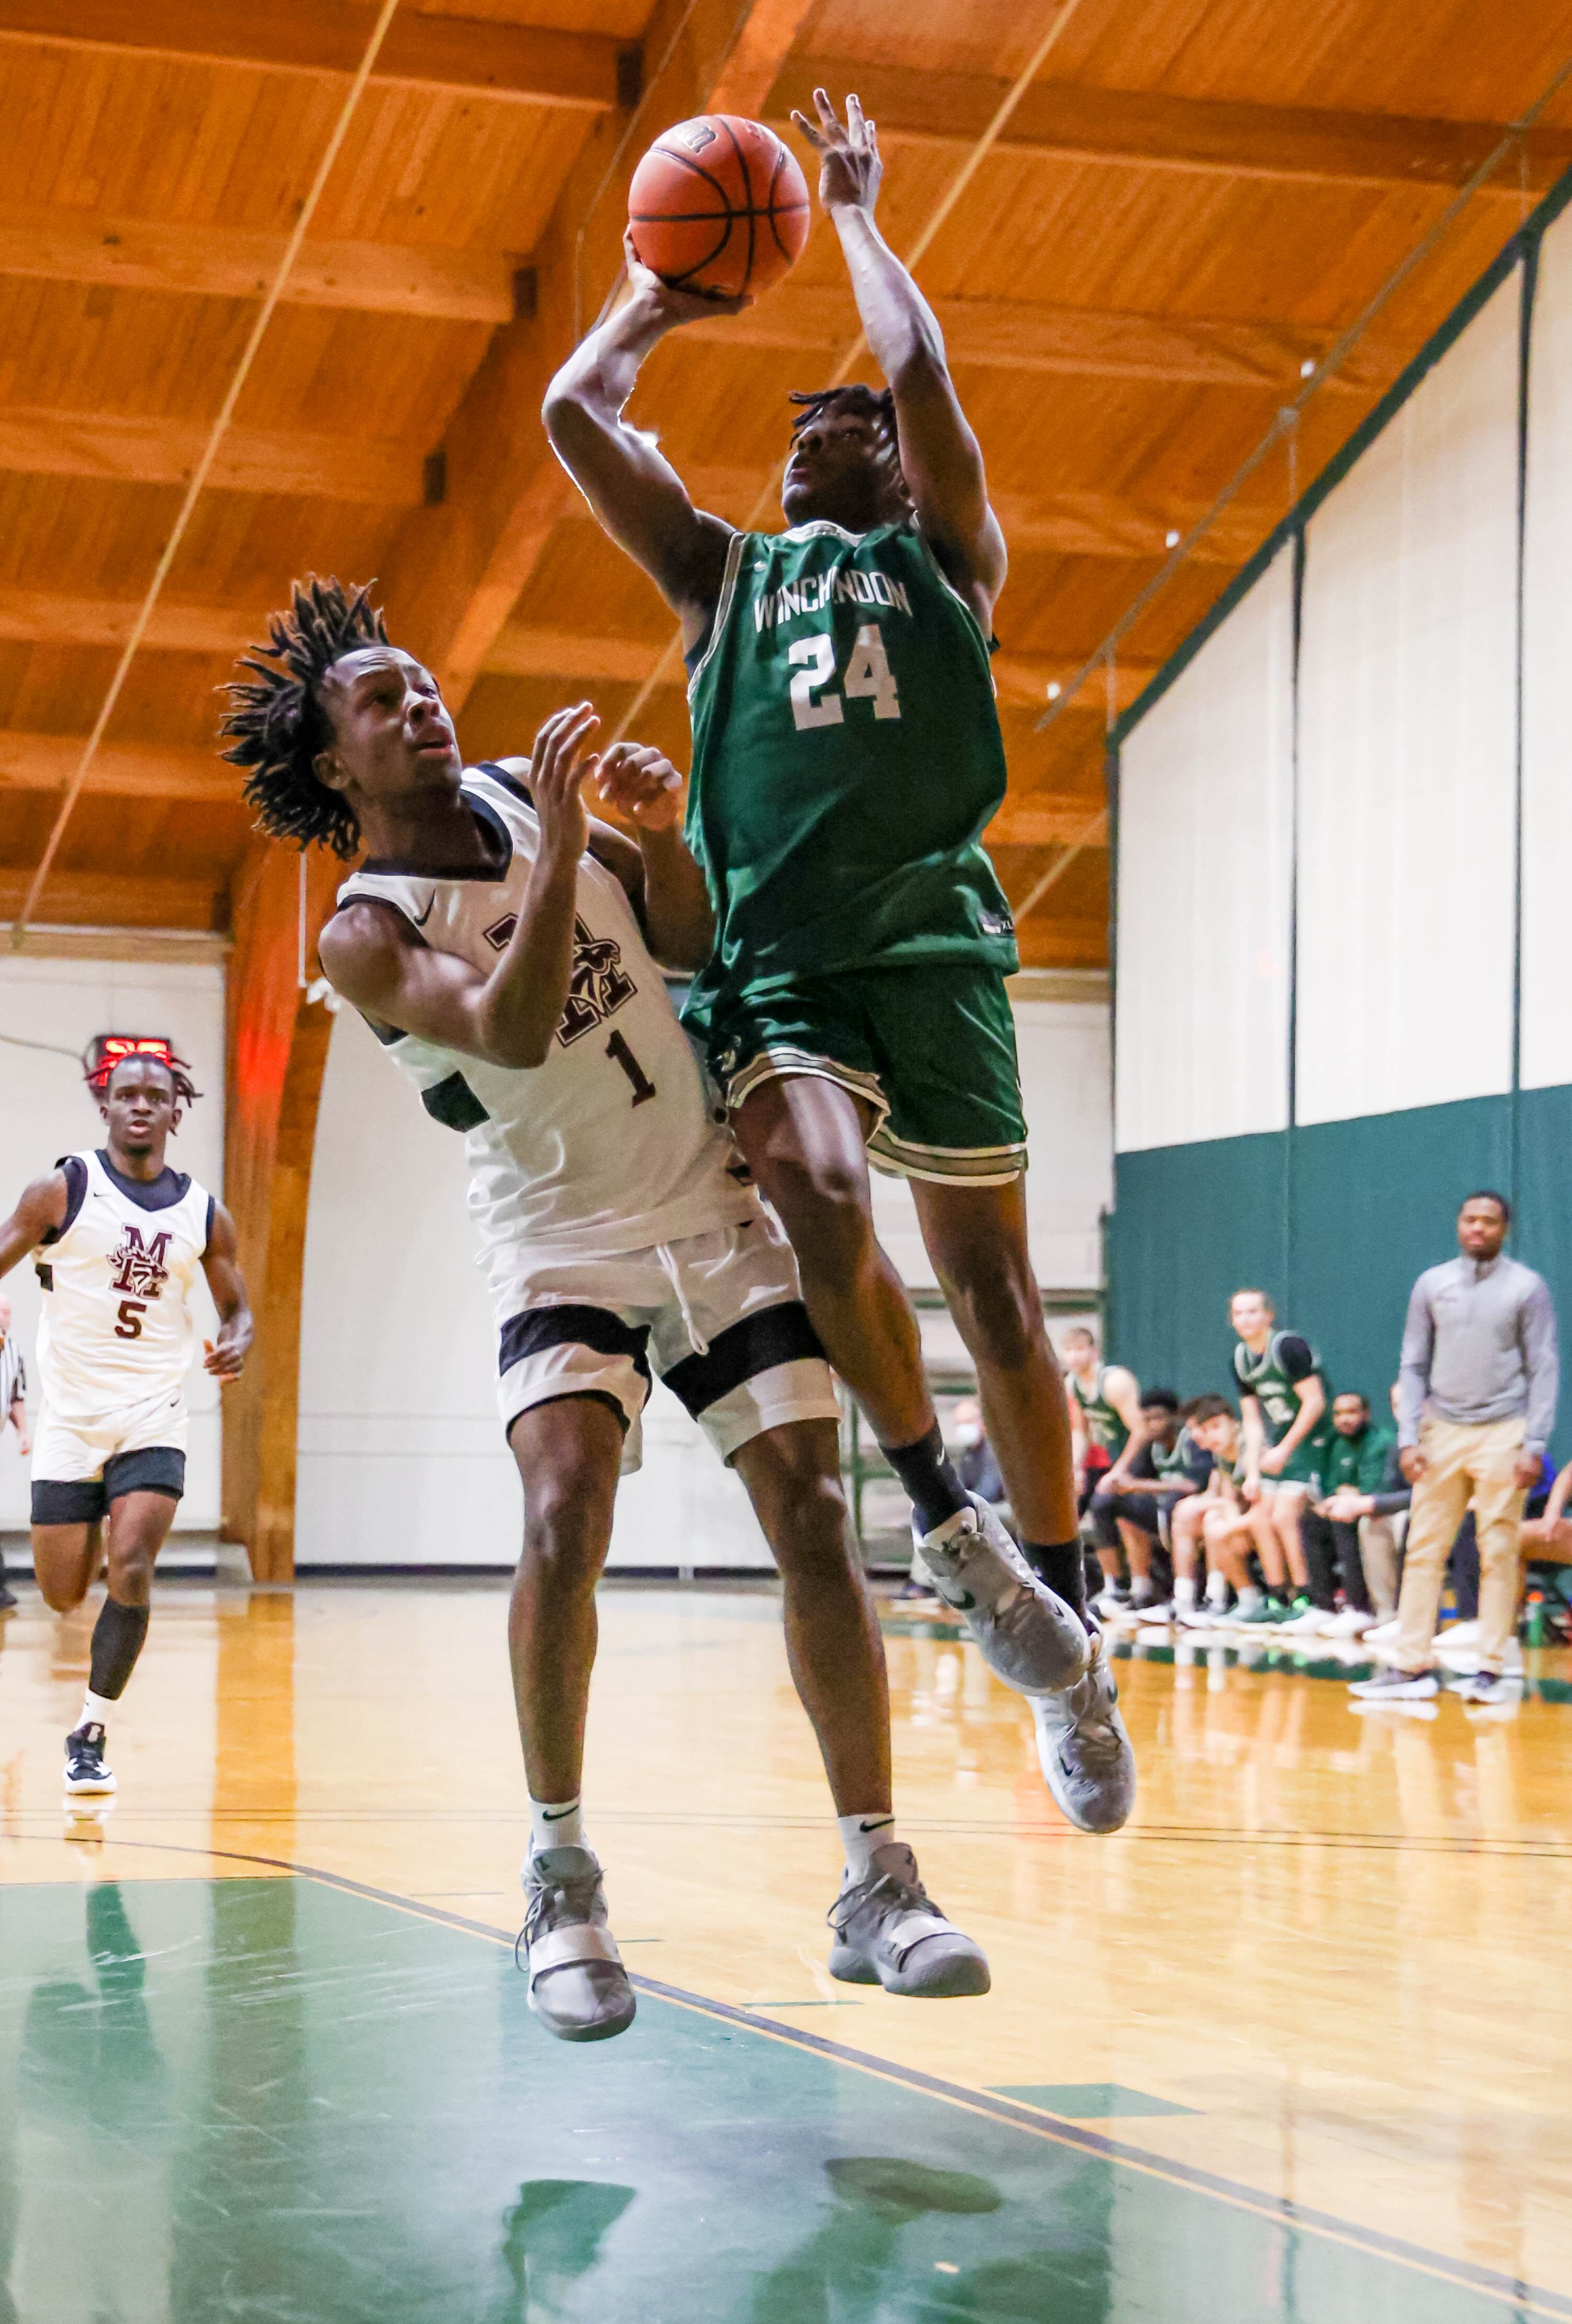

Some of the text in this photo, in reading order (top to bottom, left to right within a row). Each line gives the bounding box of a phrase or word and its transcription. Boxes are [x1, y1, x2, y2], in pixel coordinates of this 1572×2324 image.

[788, 624, 901, 731] 24
[605, 1029, 656, 1108] 1
[114, 1300, 147, 1339] 5
